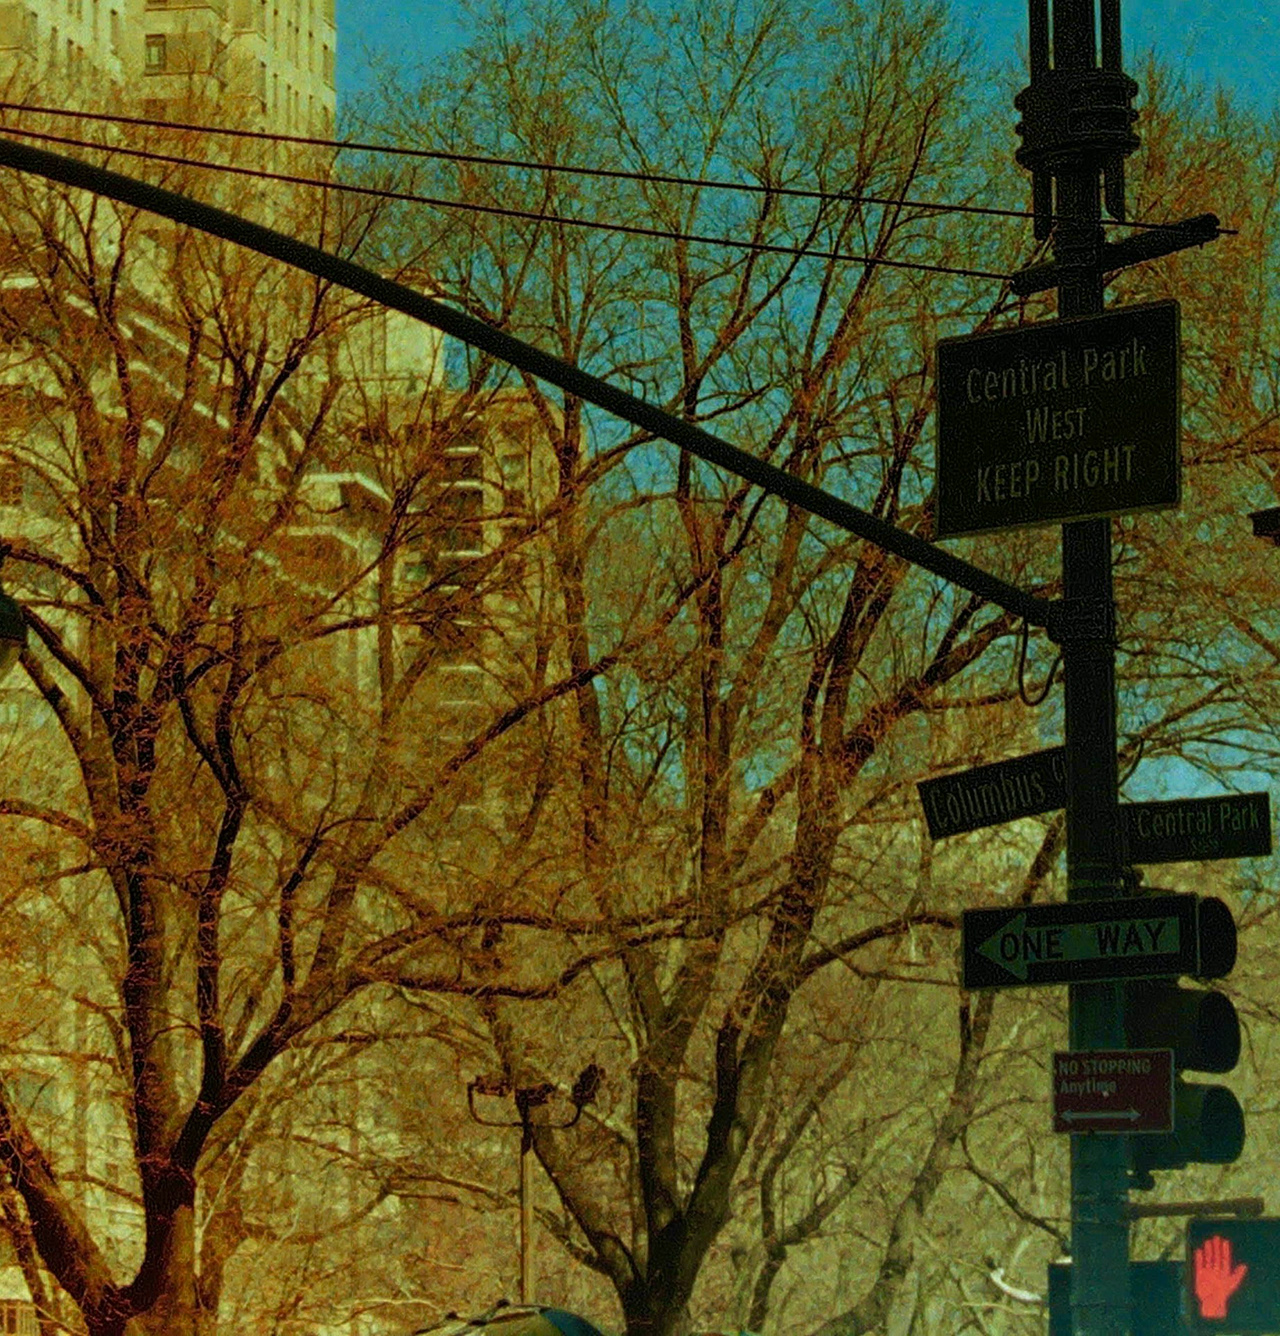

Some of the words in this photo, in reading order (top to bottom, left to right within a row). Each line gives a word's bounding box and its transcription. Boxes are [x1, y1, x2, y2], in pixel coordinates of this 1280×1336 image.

[966, 350, 1069, 403] Central
[1083, 338, 1147, 385] Park
[1026, 407, 1087, 443] WEST
[977, 460, 1040, 502] KEEP
[1054, 445, 1136, 491] RIGHT
[930, 770, 1046, 828] Columbus
[1137, 807, 1212, 838] Central
[1220, 801, 1259, 832] Park
[1000, 929, 1064, 961] ONE
[1097, 921, 1166, 956] WAY
[1058, 1060, 1078, 1075] NO
[1082, 1058, 1151, 1075] STOPPING
